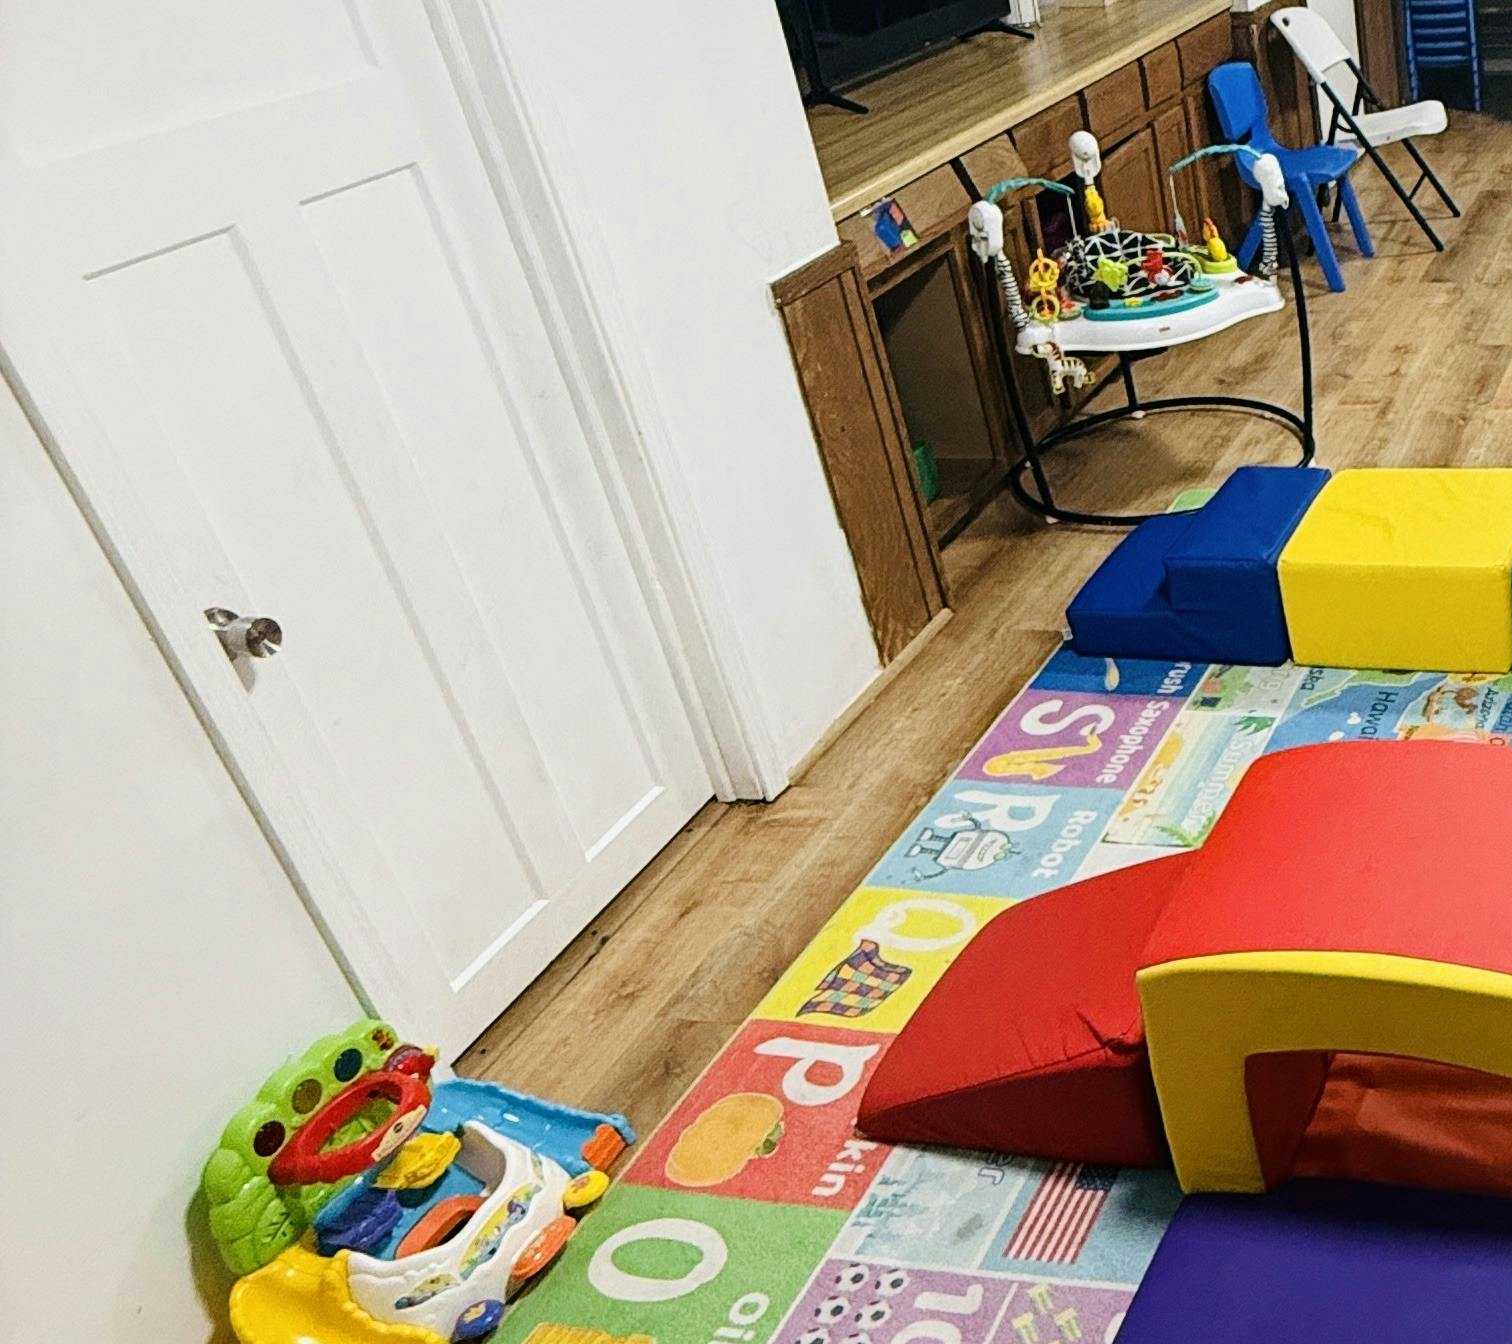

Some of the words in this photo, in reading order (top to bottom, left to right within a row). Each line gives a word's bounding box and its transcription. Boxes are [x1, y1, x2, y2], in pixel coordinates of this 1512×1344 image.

[1019, 697, 1115, 737] S
[1100, 699, 1171, 785] Saxophone
[950, 788, 1062, 833] R
[1030, 809, 1099, 880] Robot
[852, 897, 978, 953] Q
[753, 1035, 882, 1108] P
[587, 1216, 729, 1303] O
